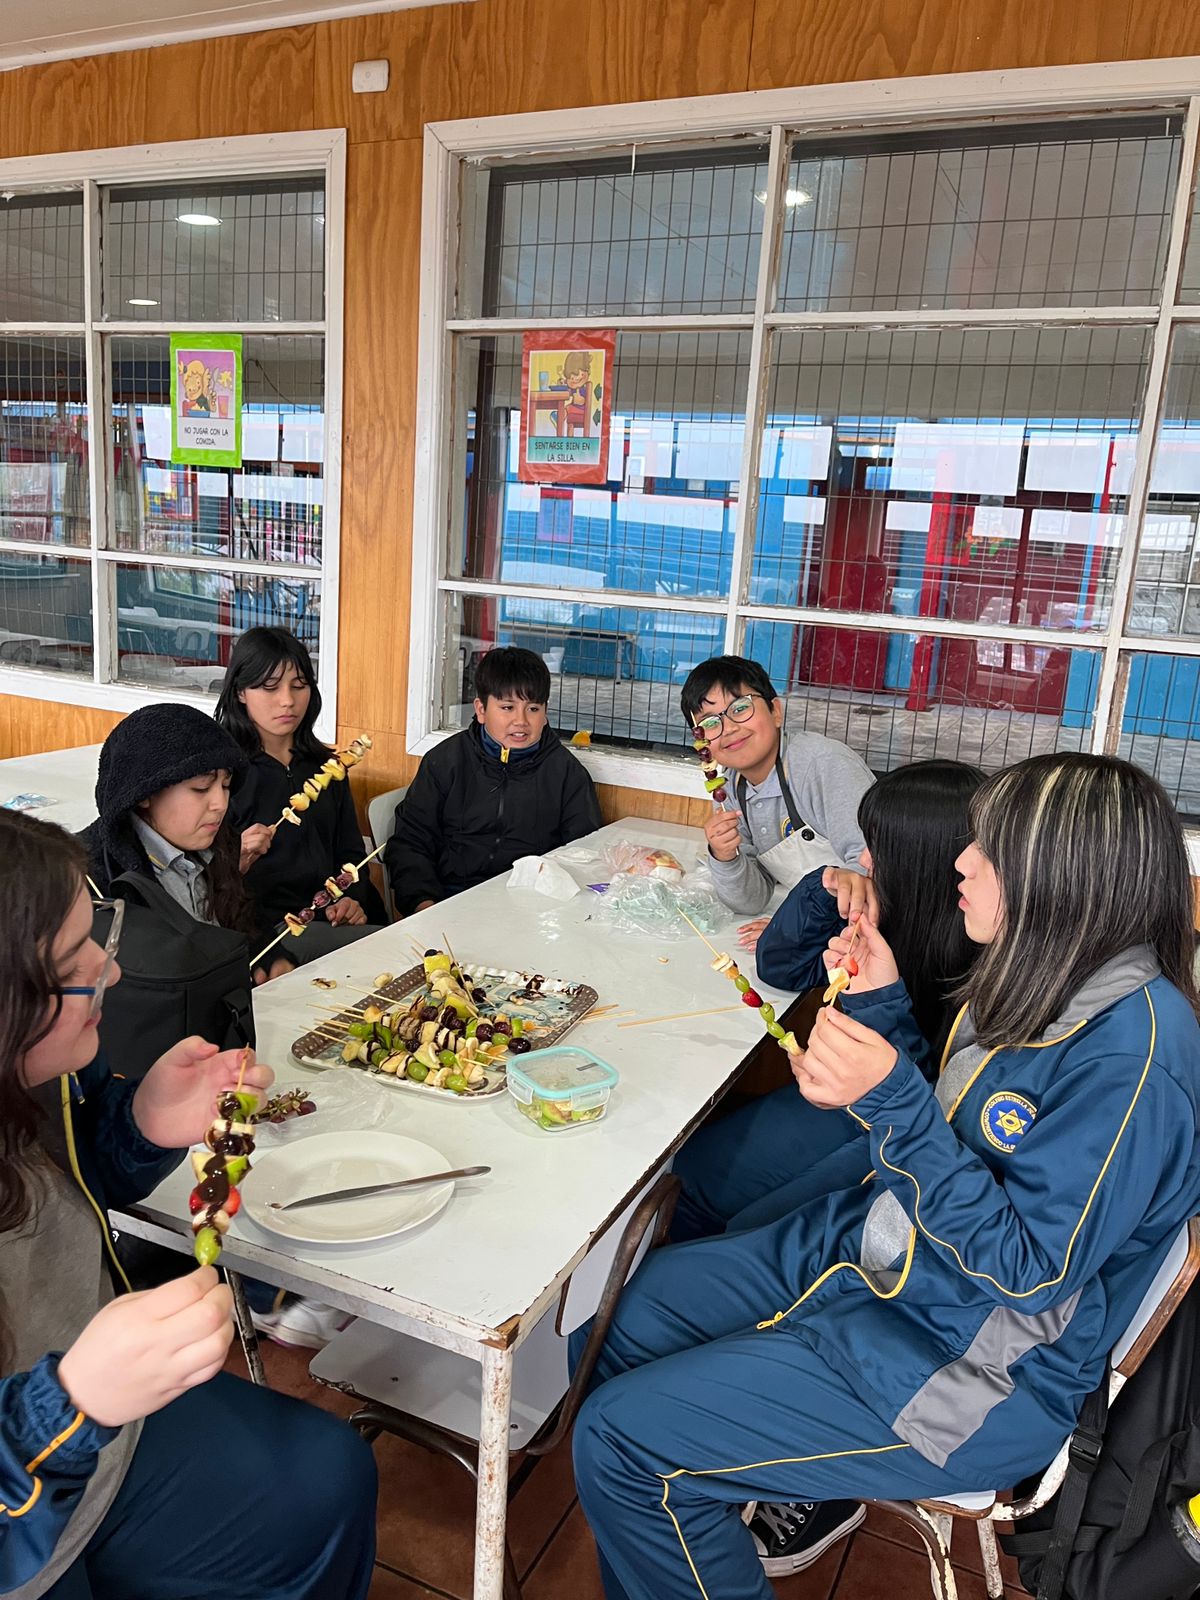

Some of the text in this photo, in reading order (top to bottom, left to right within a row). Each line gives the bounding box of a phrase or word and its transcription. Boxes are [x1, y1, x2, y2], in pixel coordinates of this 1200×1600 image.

[184, 426, 228, 436] NO JUGAR CON LA
[535, 441, 590, 451] SENTARSE BIEN EN
[547, 453, 576, 462] LA SILLA.
